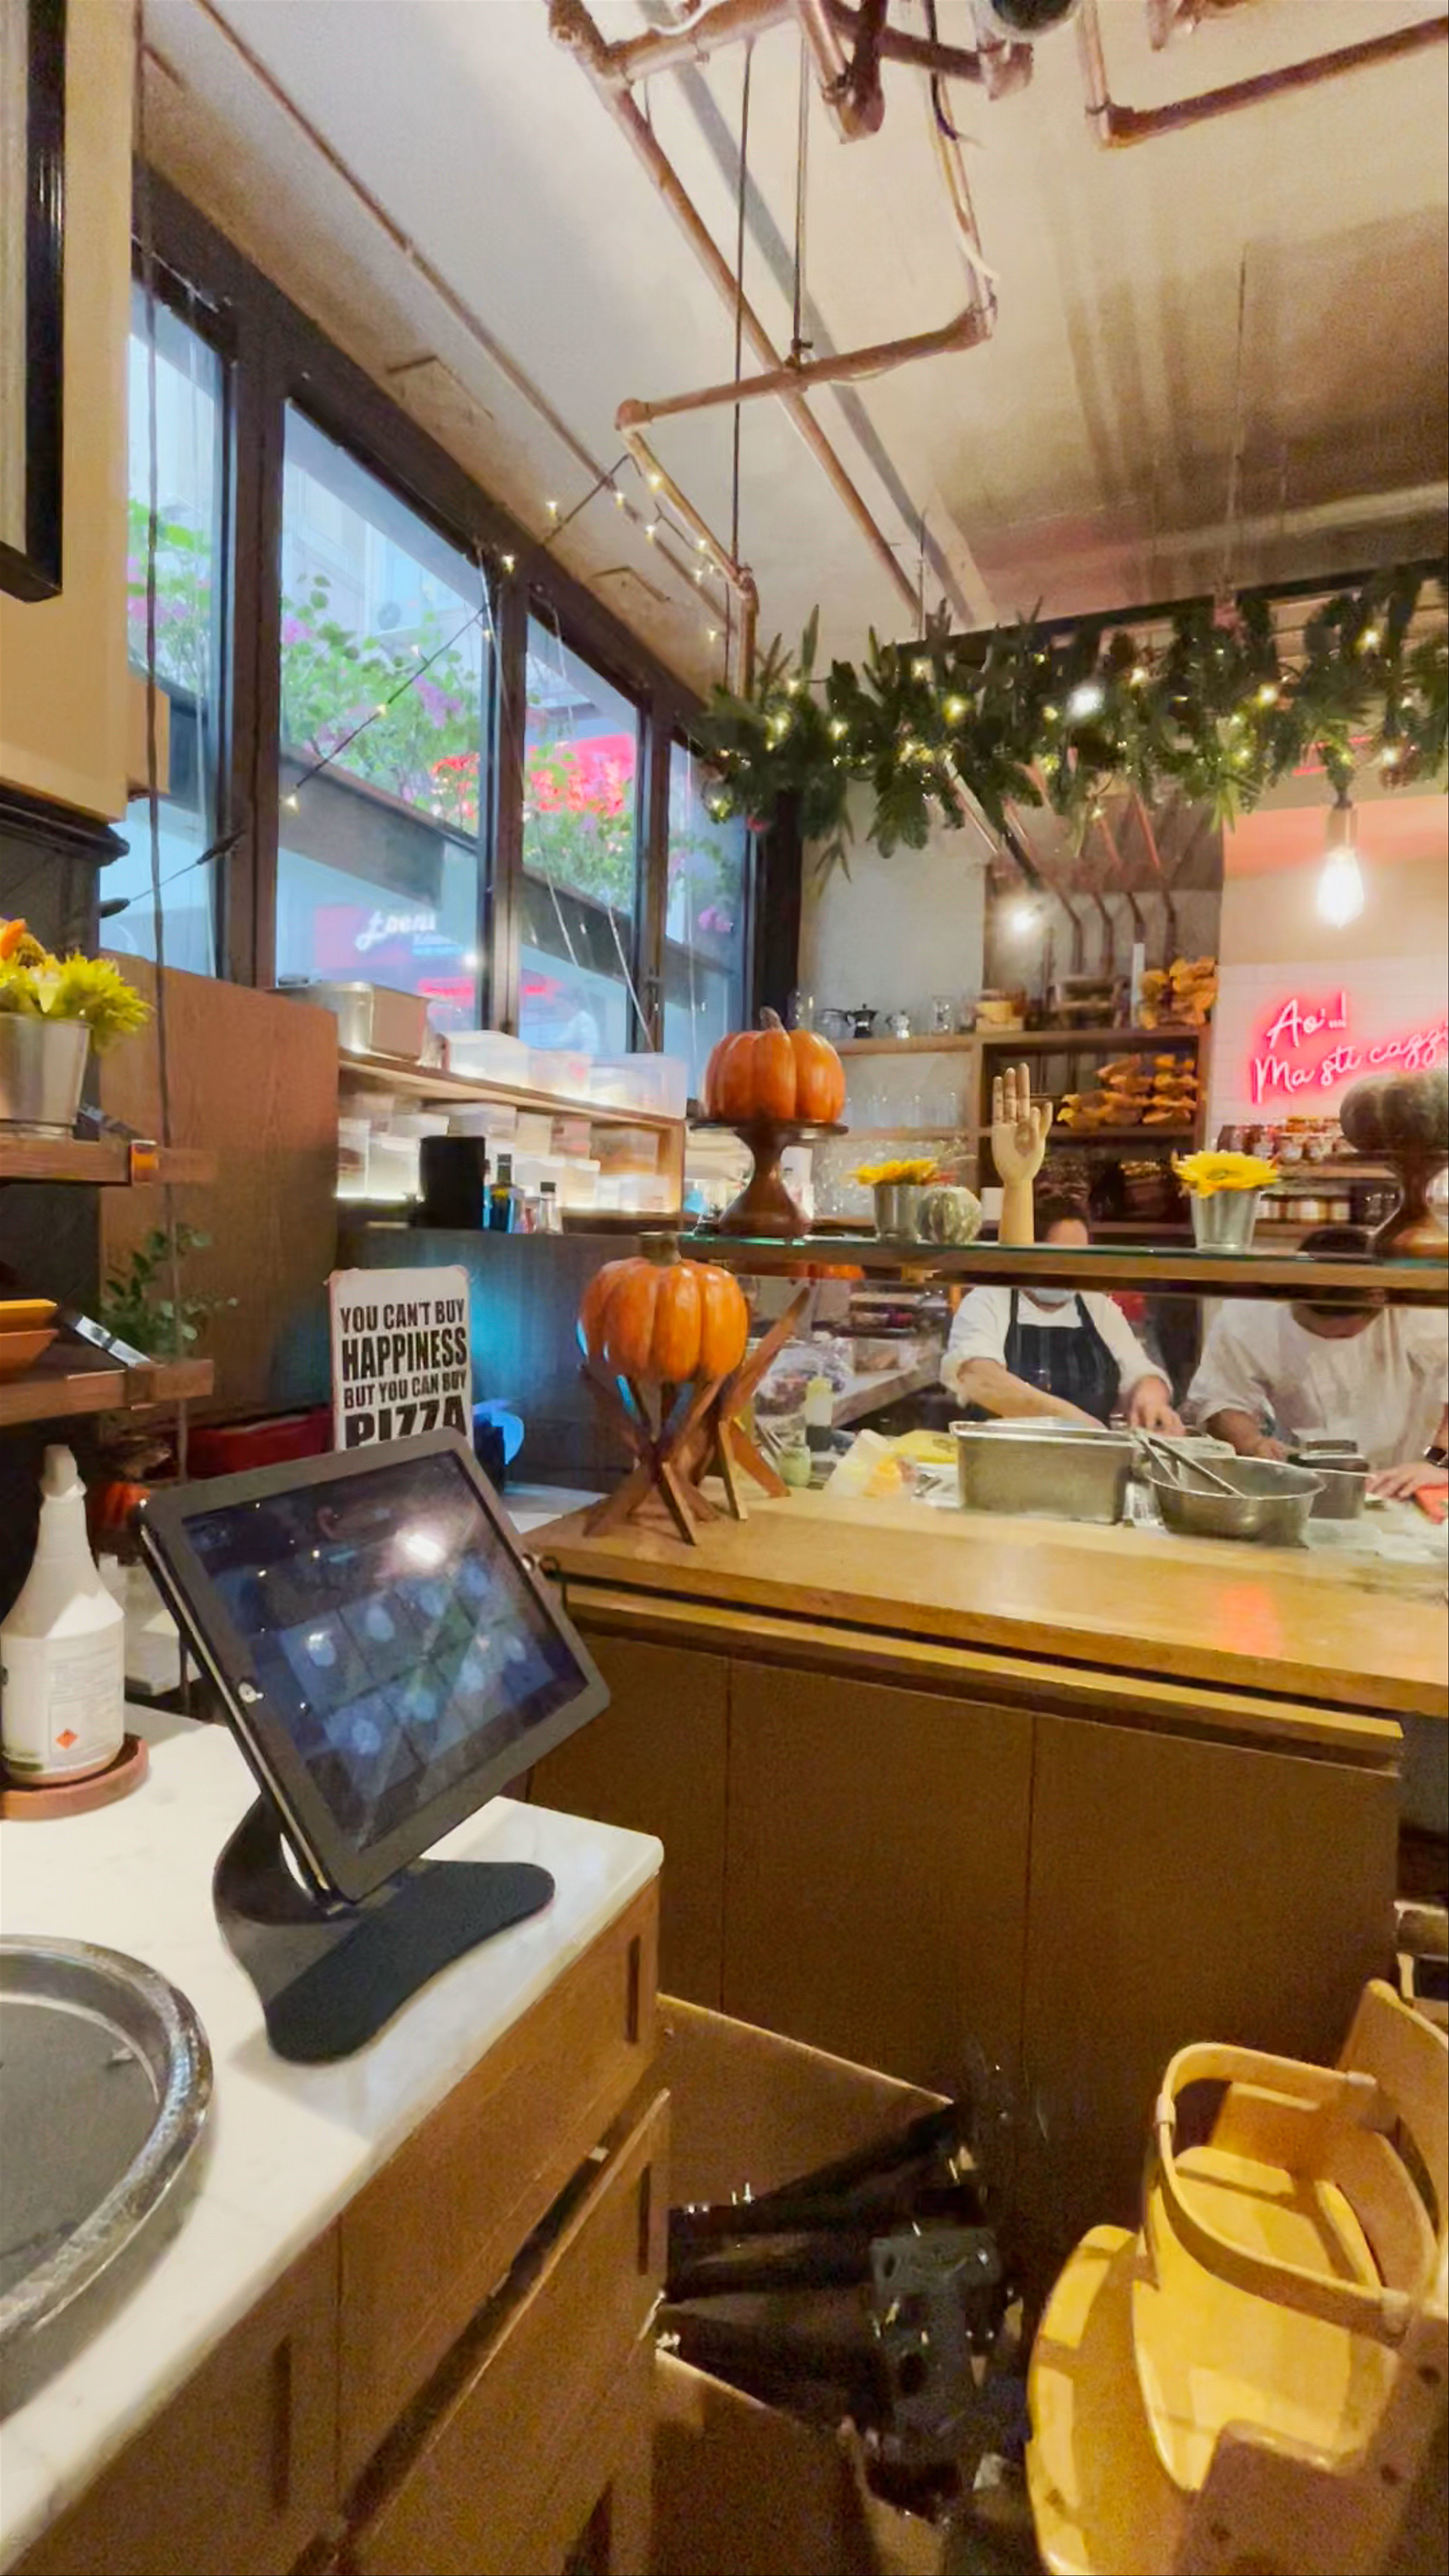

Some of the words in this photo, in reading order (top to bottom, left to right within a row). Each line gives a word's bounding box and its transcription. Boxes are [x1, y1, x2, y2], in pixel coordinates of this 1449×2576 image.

[1254, 1054, 1315, 1104] Ma
[340, 1306, 378, 1333] YOU
[383, 1302, 431, 1330] CAN'T
[435, 1298, 465, 1325] BUY
[341, 1327, 467, 1382] HAPPINESS
[344, 1384, 375, 1409] BUT
[378, 1378, 408, 1403] YOU
[412, 1373, 439, 1397] CAN
[442, 1370, 466, 1392] BUY
[345, 1395, 467, 1449] PIZZA
